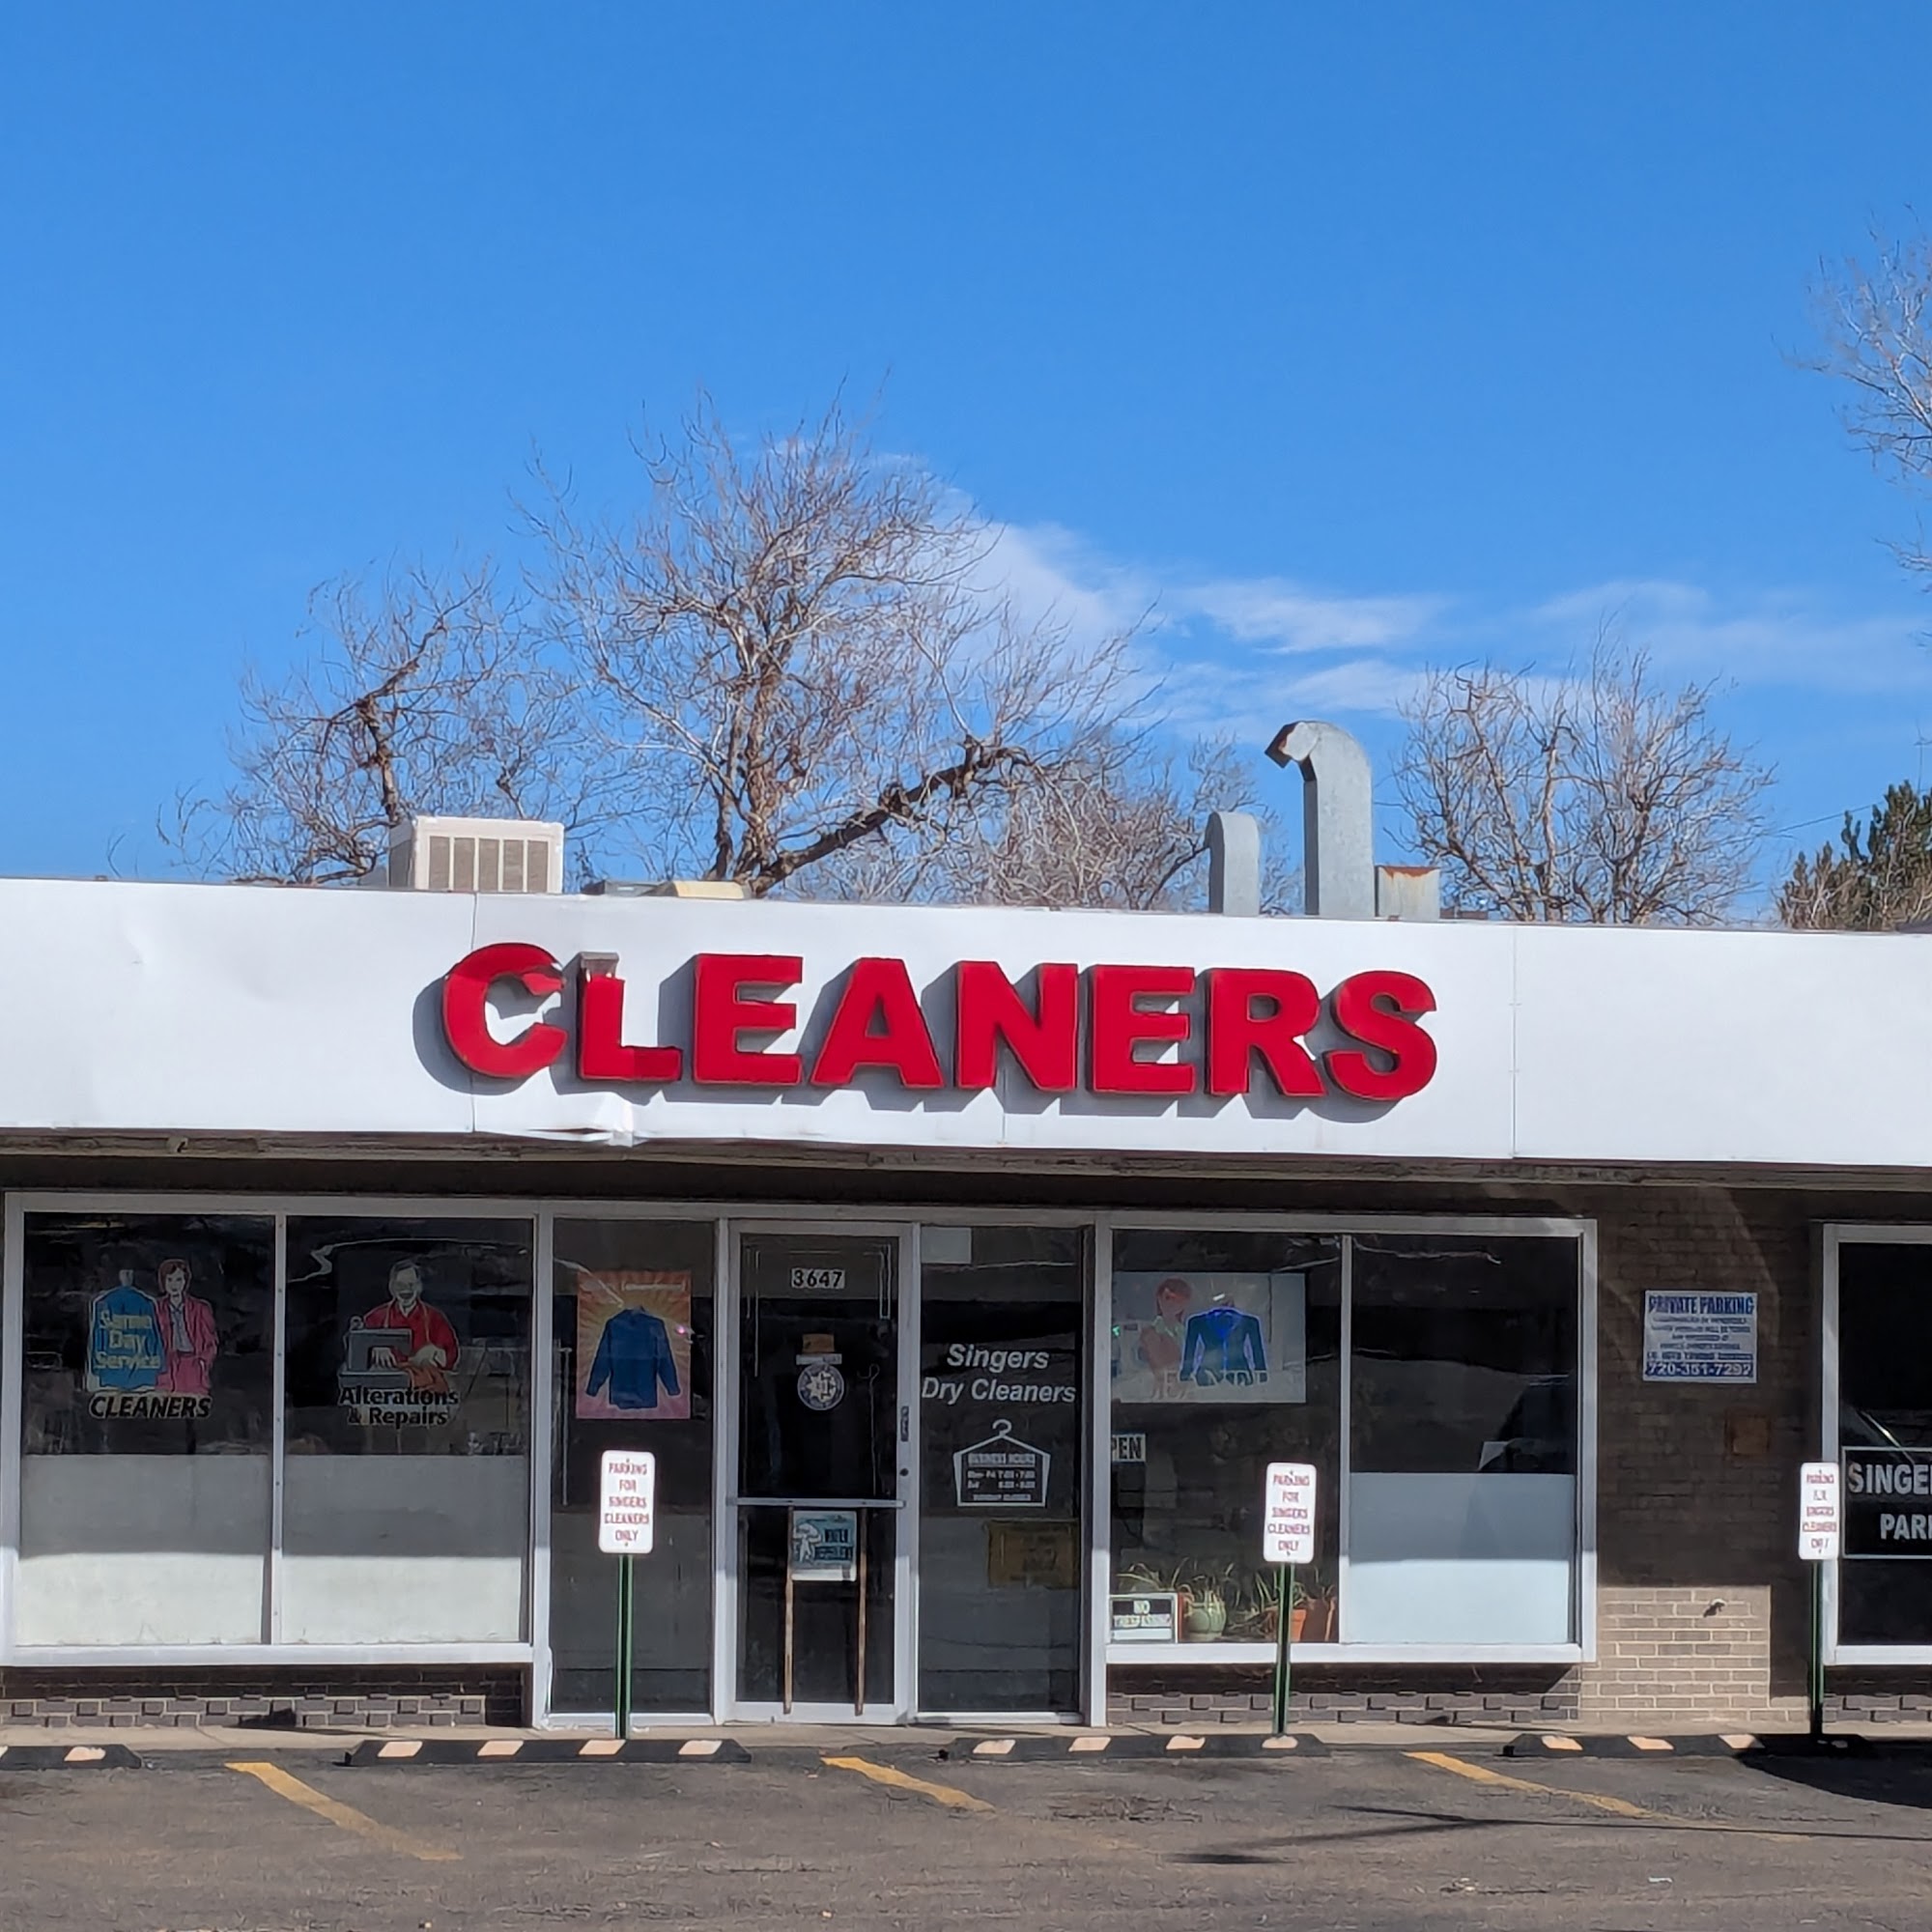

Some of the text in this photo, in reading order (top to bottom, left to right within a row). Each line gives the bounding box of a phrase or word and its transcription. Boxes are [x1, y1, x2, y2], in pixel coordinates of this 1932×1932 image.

[442, 942, 1436, 1101] CLEANERS
[793, 1269, 842, 1288] 3647
[1649, 1295, 1754, 1315] PRIVATE PARKING
[109, 1330, 148, 1355] Day
[947, 1343, 1050, 1374] Singers
[339, 1385, 459, 1405] Alterations
[922, 1377, 1076, 1406] Dry Cleaners
[90, 1395, 212, 1418] CLEANERS
[369, 1406, 448, 1430] Repairs
[1112, 1436, 1141, 1459] PEN
[609, 1463, 647, 1476] PARKING
[1848, 1463, 1932, 1494] SINGE
[619, 1479, 637, 1492] FOR
[1273, 1475, 1310, 1487] PARKING
[604, 1513, 649, 1524] CLEANERS
[615, 1529, 639, 1542] ONLY
